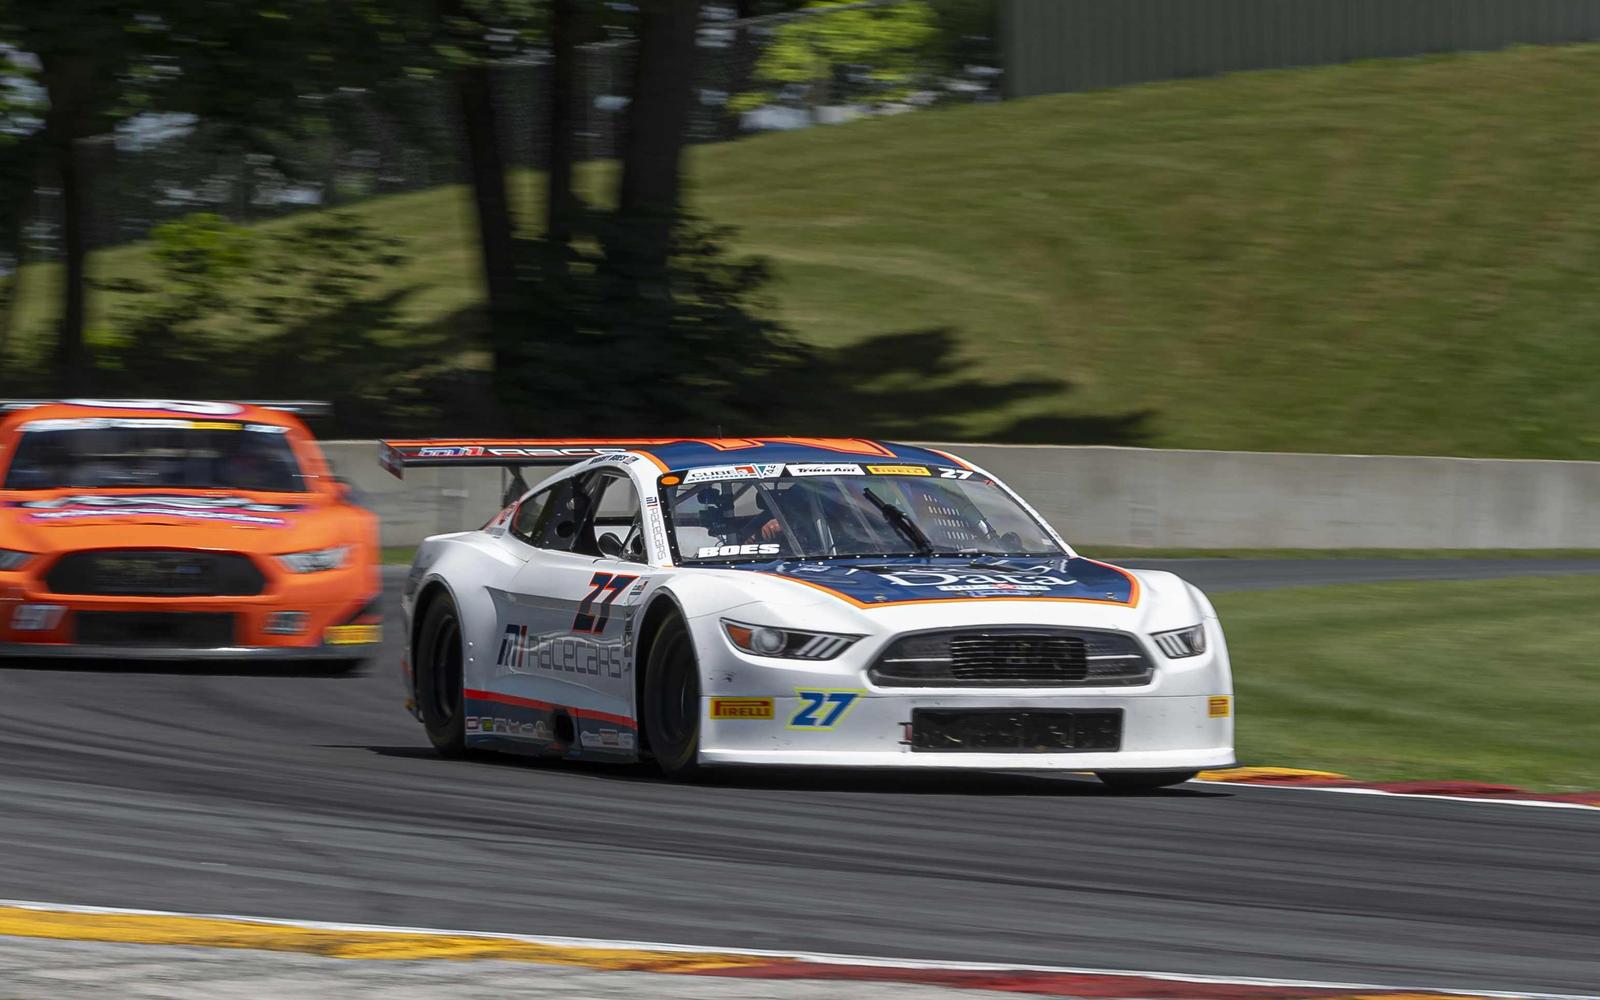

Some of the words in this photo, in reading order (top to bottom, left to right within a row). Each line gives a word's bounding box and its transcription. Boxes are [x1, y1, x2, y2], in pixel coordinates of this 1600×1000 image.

[938, 467, 974, 480] 27
[698, 543, 780, 558] BOES
[879, 571, 1077, 587] Data
[571, 571, 640, 635] 27
[714, 700, 771, 717] PIRELLI
[791, 692, 859, 727] 27
